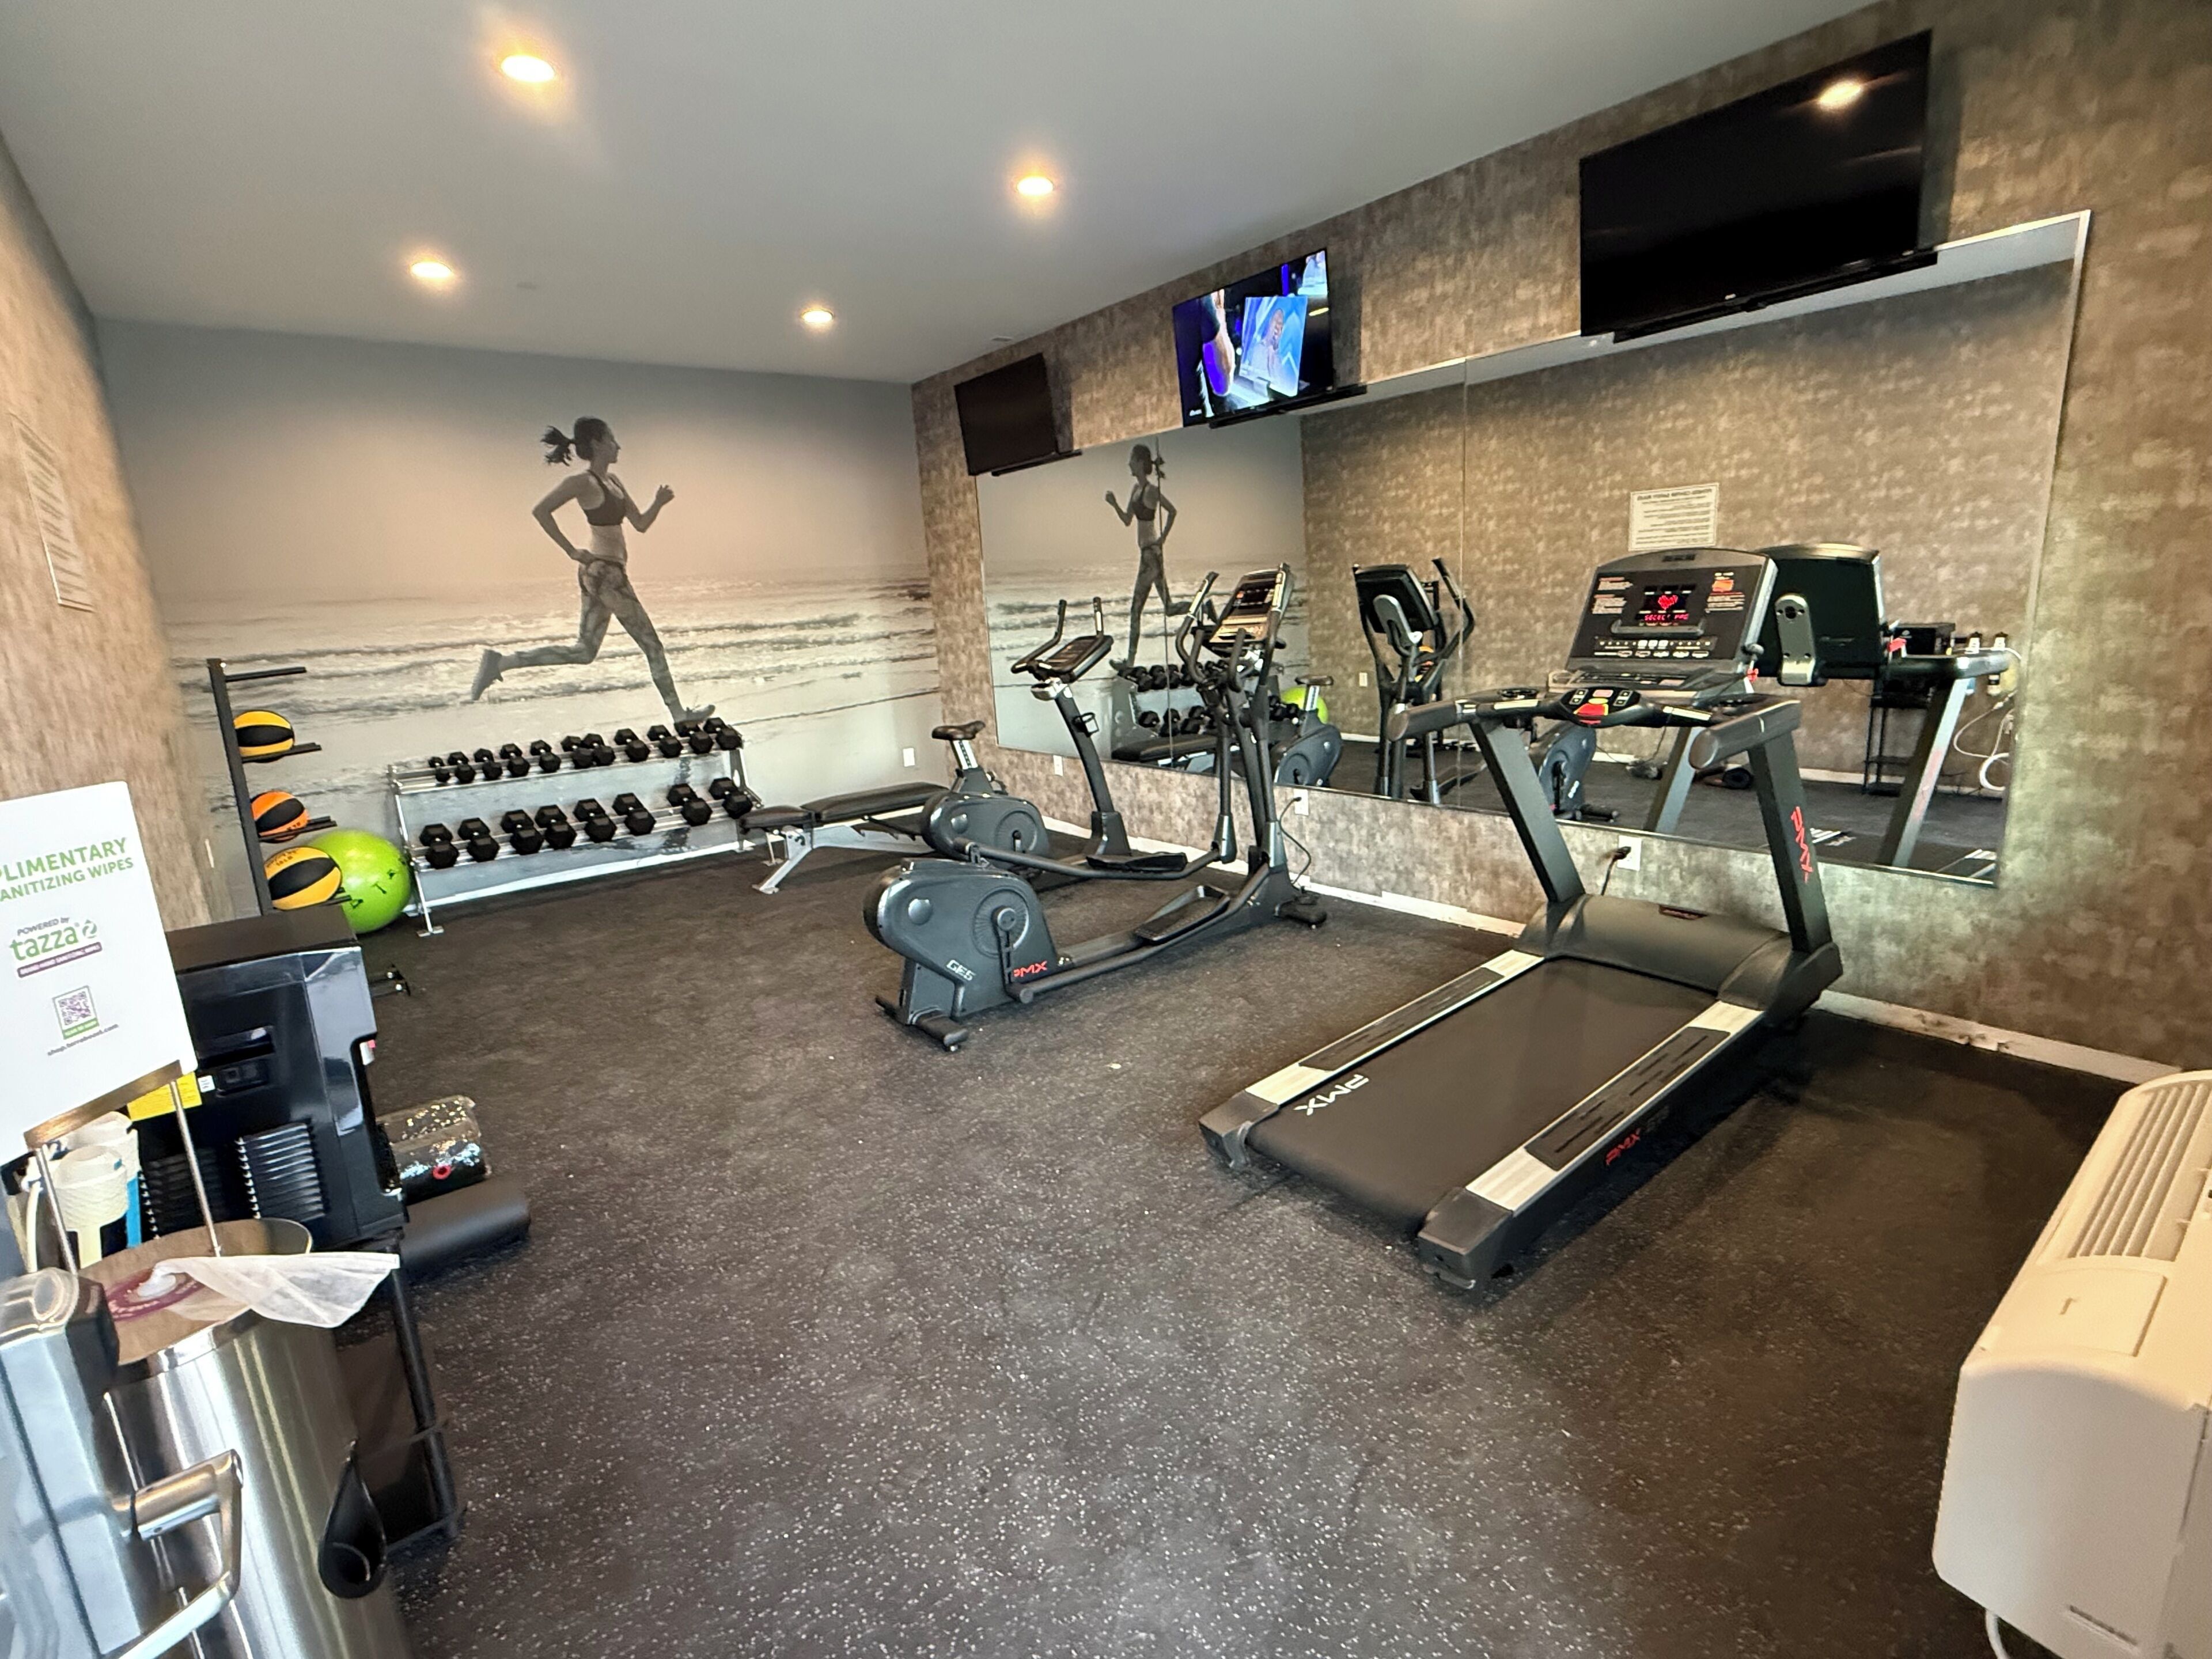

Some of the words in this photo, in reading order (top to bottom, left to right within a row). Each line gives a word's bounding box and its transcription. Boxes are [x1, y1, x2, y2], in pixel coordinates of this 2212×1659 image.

[0, 837, 126, 882] LIMENTARY
[1790, 806, 1813, 884] PMX
[87, 857, 134, 878] WIPES
[9, 926, 79, 961] tazza
[17, 918, 59, 936] POWERED
[1013, 960, 1048, 978] PMX
[1293, 1074, 1370, 1116] PMX
[1605, 1128, 1641, 1166] PMX
